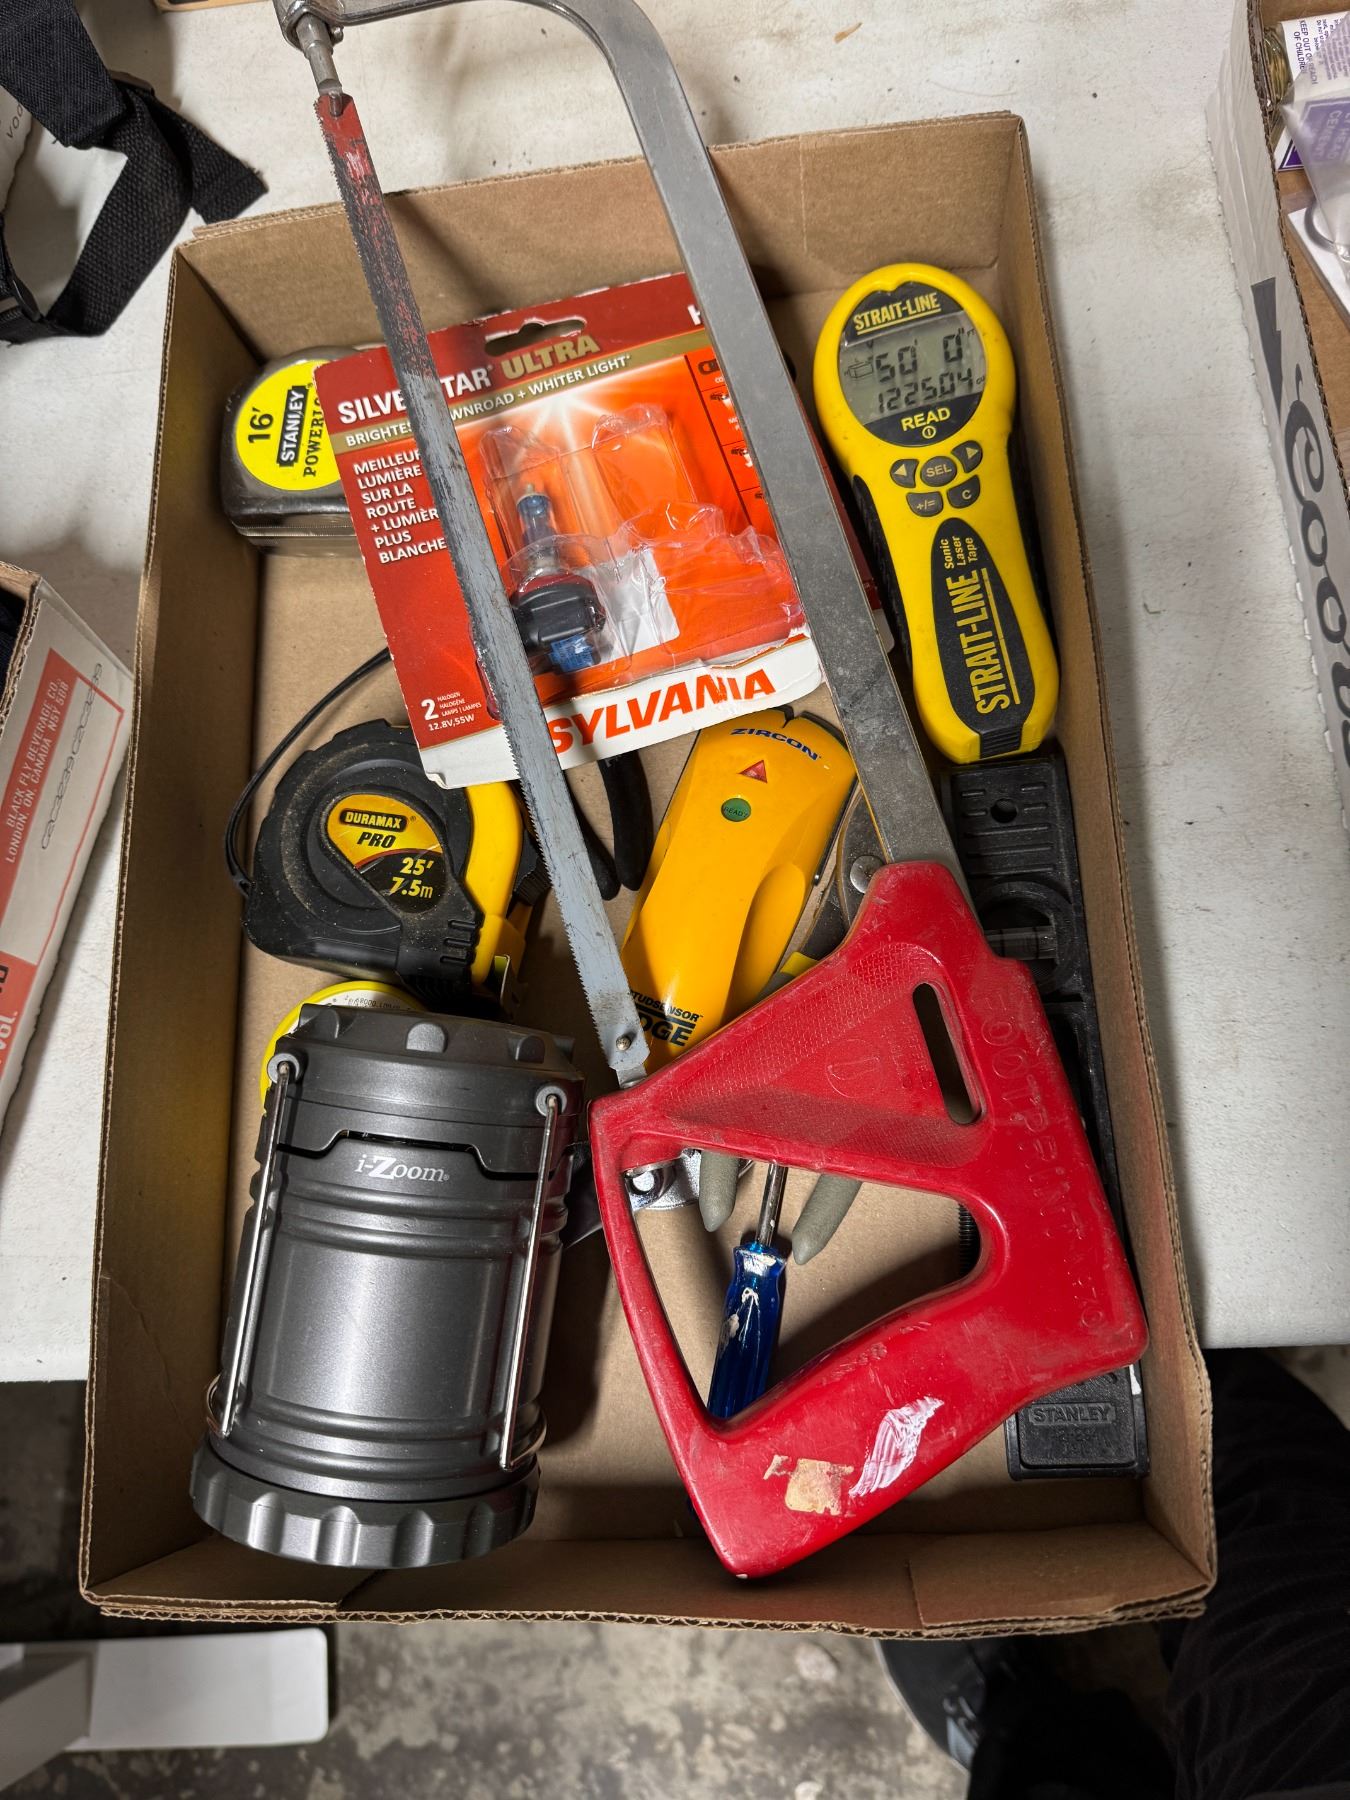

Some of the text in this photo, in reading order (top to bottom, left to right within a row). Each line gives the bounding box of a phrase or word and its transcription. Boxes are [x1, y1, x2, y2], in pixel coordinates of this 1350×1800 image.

[1293, 31, 1300, 42] OF
[1303, 37, 1312, 53] OUT
[853, 292, 940, 331] STRAIT-LINE
[338, 335, 601, 425] SILVETAR ULTRA
[346, 421, 413, 447] BRIGHTES
[450, 391, 515, 422] WNROAD
[528, 369, 585, 396] WHITER
[901, 407, 951, 432] READ
[248, 407, 274, 444] 16'
[281, 390, 305, 462] STANLEY
[357, 464, 422, 490] LUMIÈRE
[926, 463, 952, 478] SEL
[361, 483, 413, 504] SUR LA
[961, 489, 972, 500] C
[365, 498, 416, 519] ROUTE
[382, 508, 439, 531] LUMIÈR
[374, 531, 412, 549] PLUS
[379, 538, 447, 564] BLANCHE
[952, 535, 966, 567] Laser
[964, 537, 978, 563] Tape
[939, 538, 955, 570] Sonic
[947, 568, 1010, 714] STRAIT-LINE
[421, 691, 461, 721] 2 HALOGEN
[547, 668, 776, 754] SYLVANIA
[730, 728, 819, 761] ZIRCON
[6, 789, 25, 828] BLACK
[19, 764, 33, 786] FLY
[26, 700, 51, 762] BEVERAGE
[30, 738, 53, 785] CANADA
[344, 811, 402, 829] DURAMAX
[357, 832, 396, 849] PRO
[400, 857, 434, 876] 25'
[390, 877, 433, 899] 7.5m
[640, 1016, 696, 1047] DGE
[354, 1154, 444, 1183] i-Zoom
[1031, 1403, 1112, 1425] STANLEY
